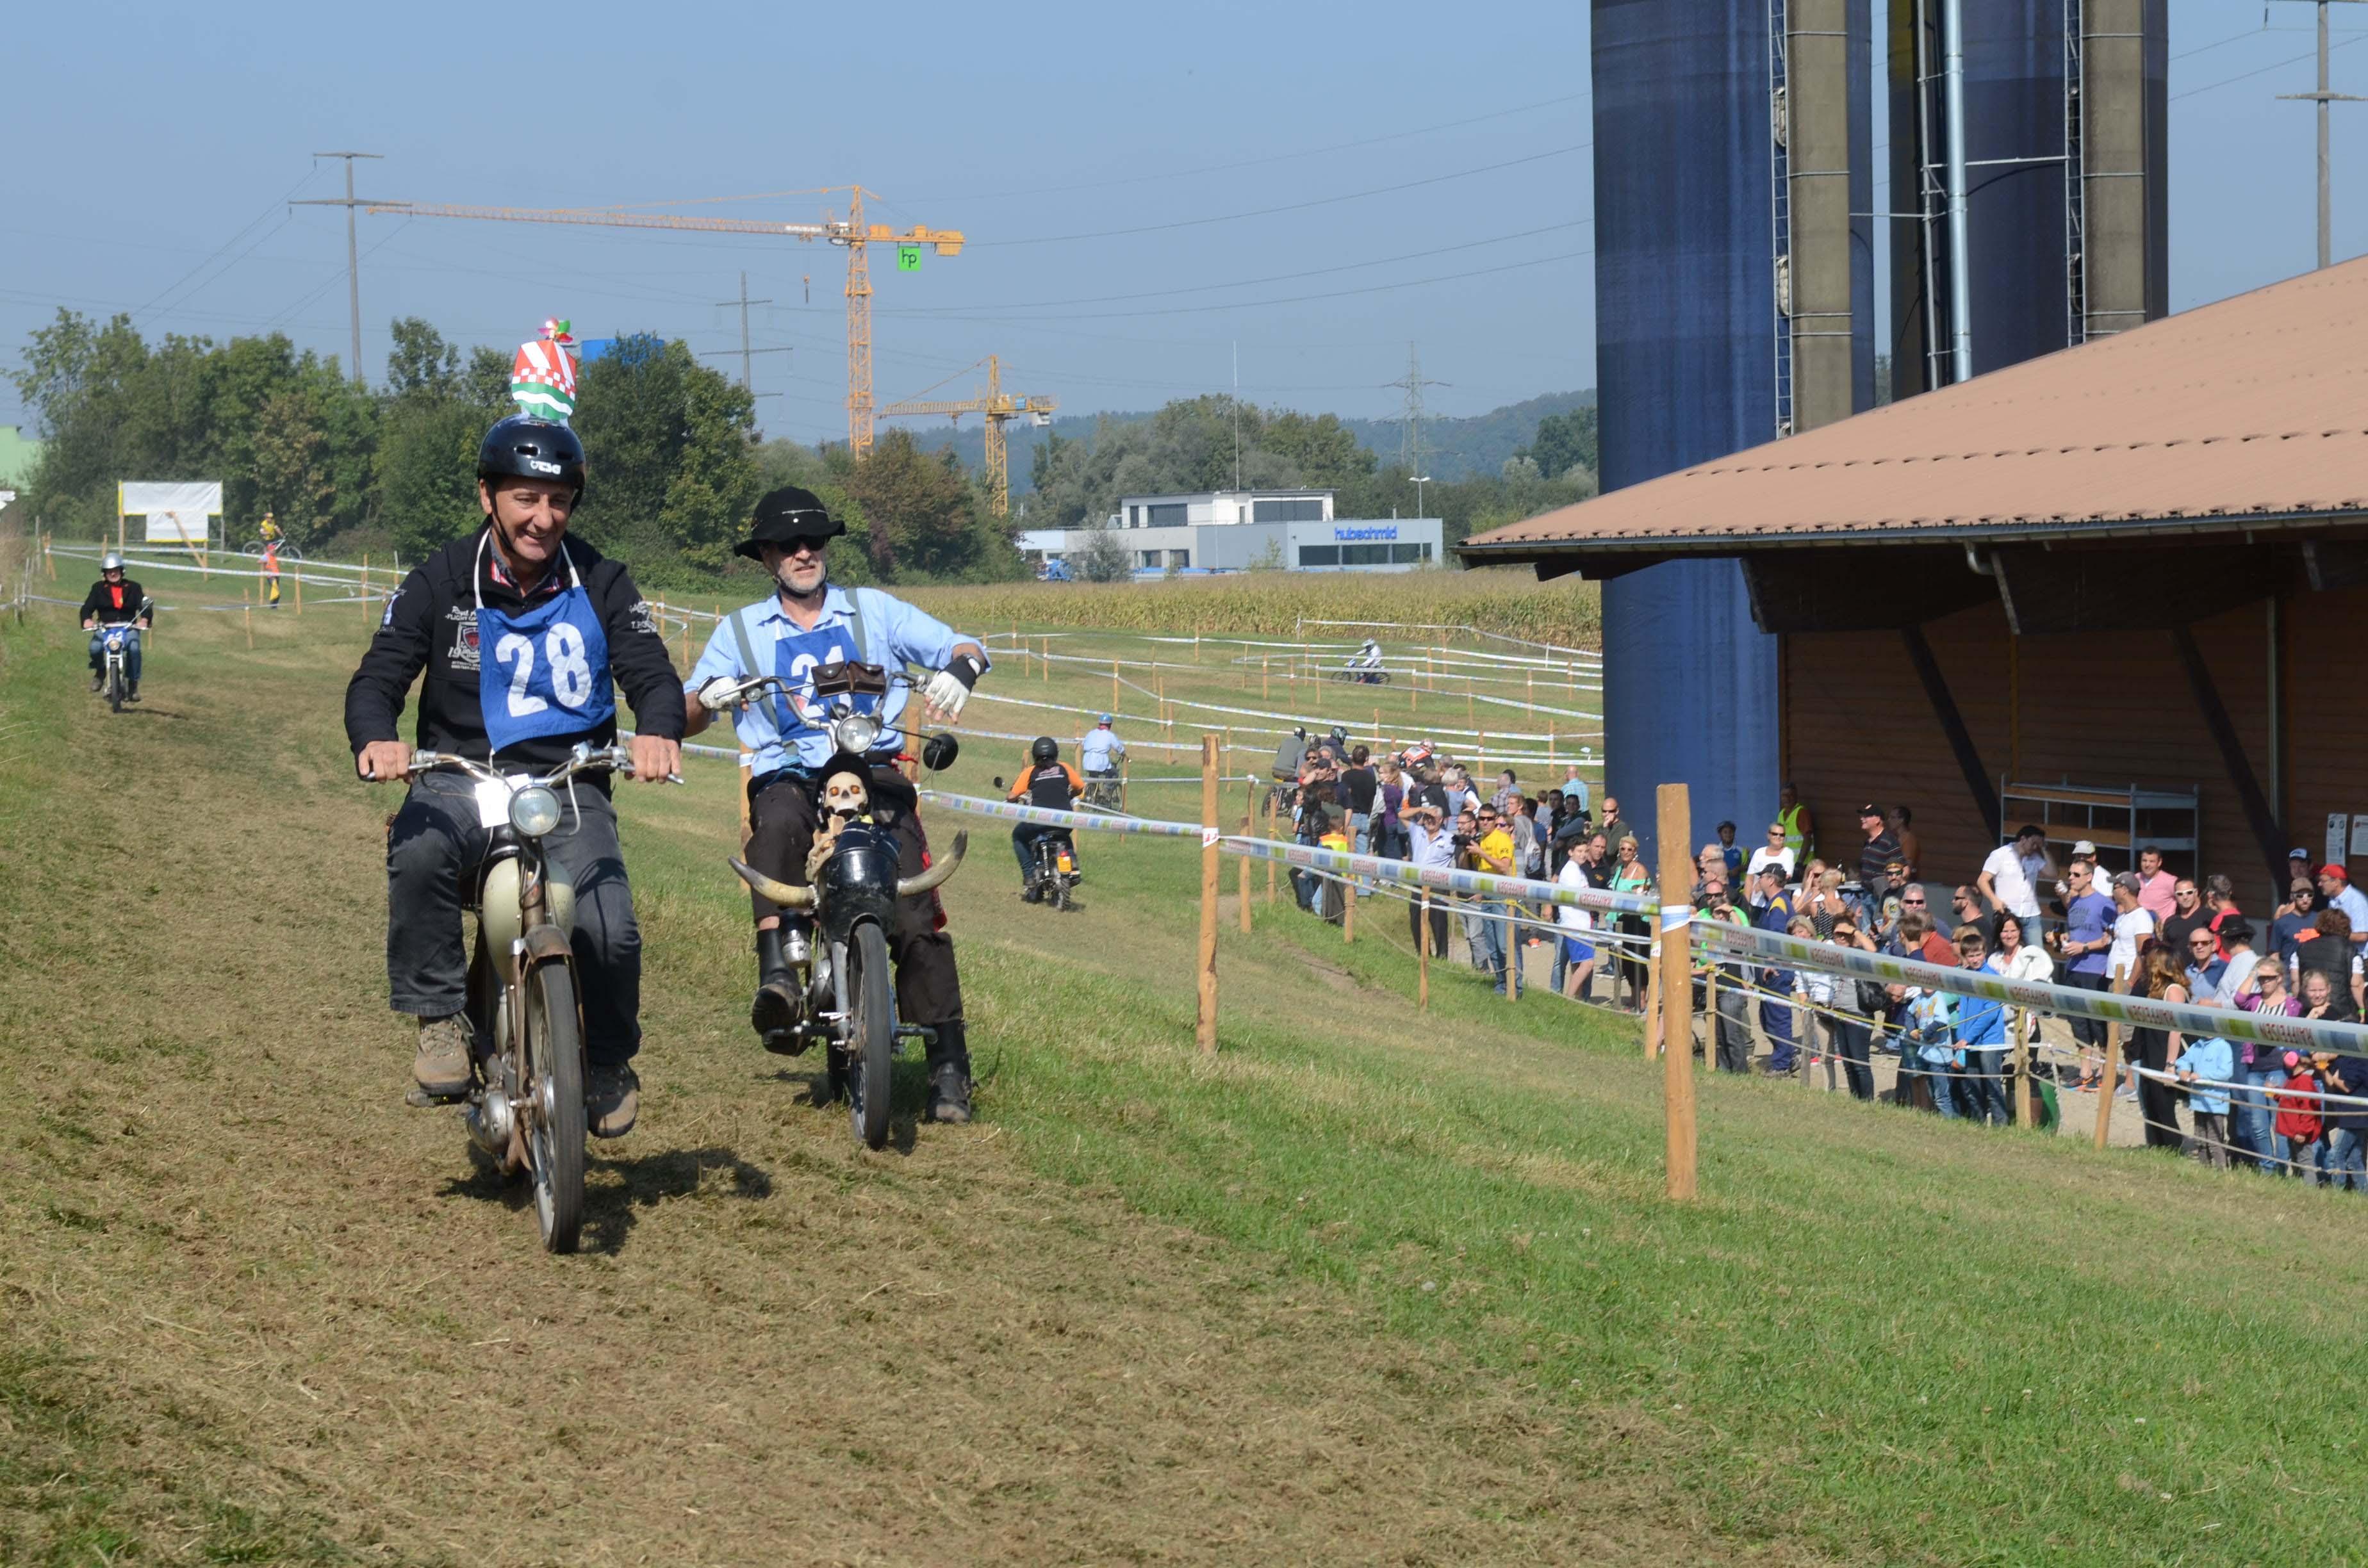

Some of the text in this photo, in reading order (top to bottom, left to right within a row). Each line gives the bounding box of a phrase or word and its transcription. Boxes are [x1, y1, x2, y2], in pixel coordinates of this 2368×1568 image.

[901, 249, 917, 268] hp
[496, 622, 592, 717] 28
[2259, 1023, 2315, 1046] RAIFFEISEN
